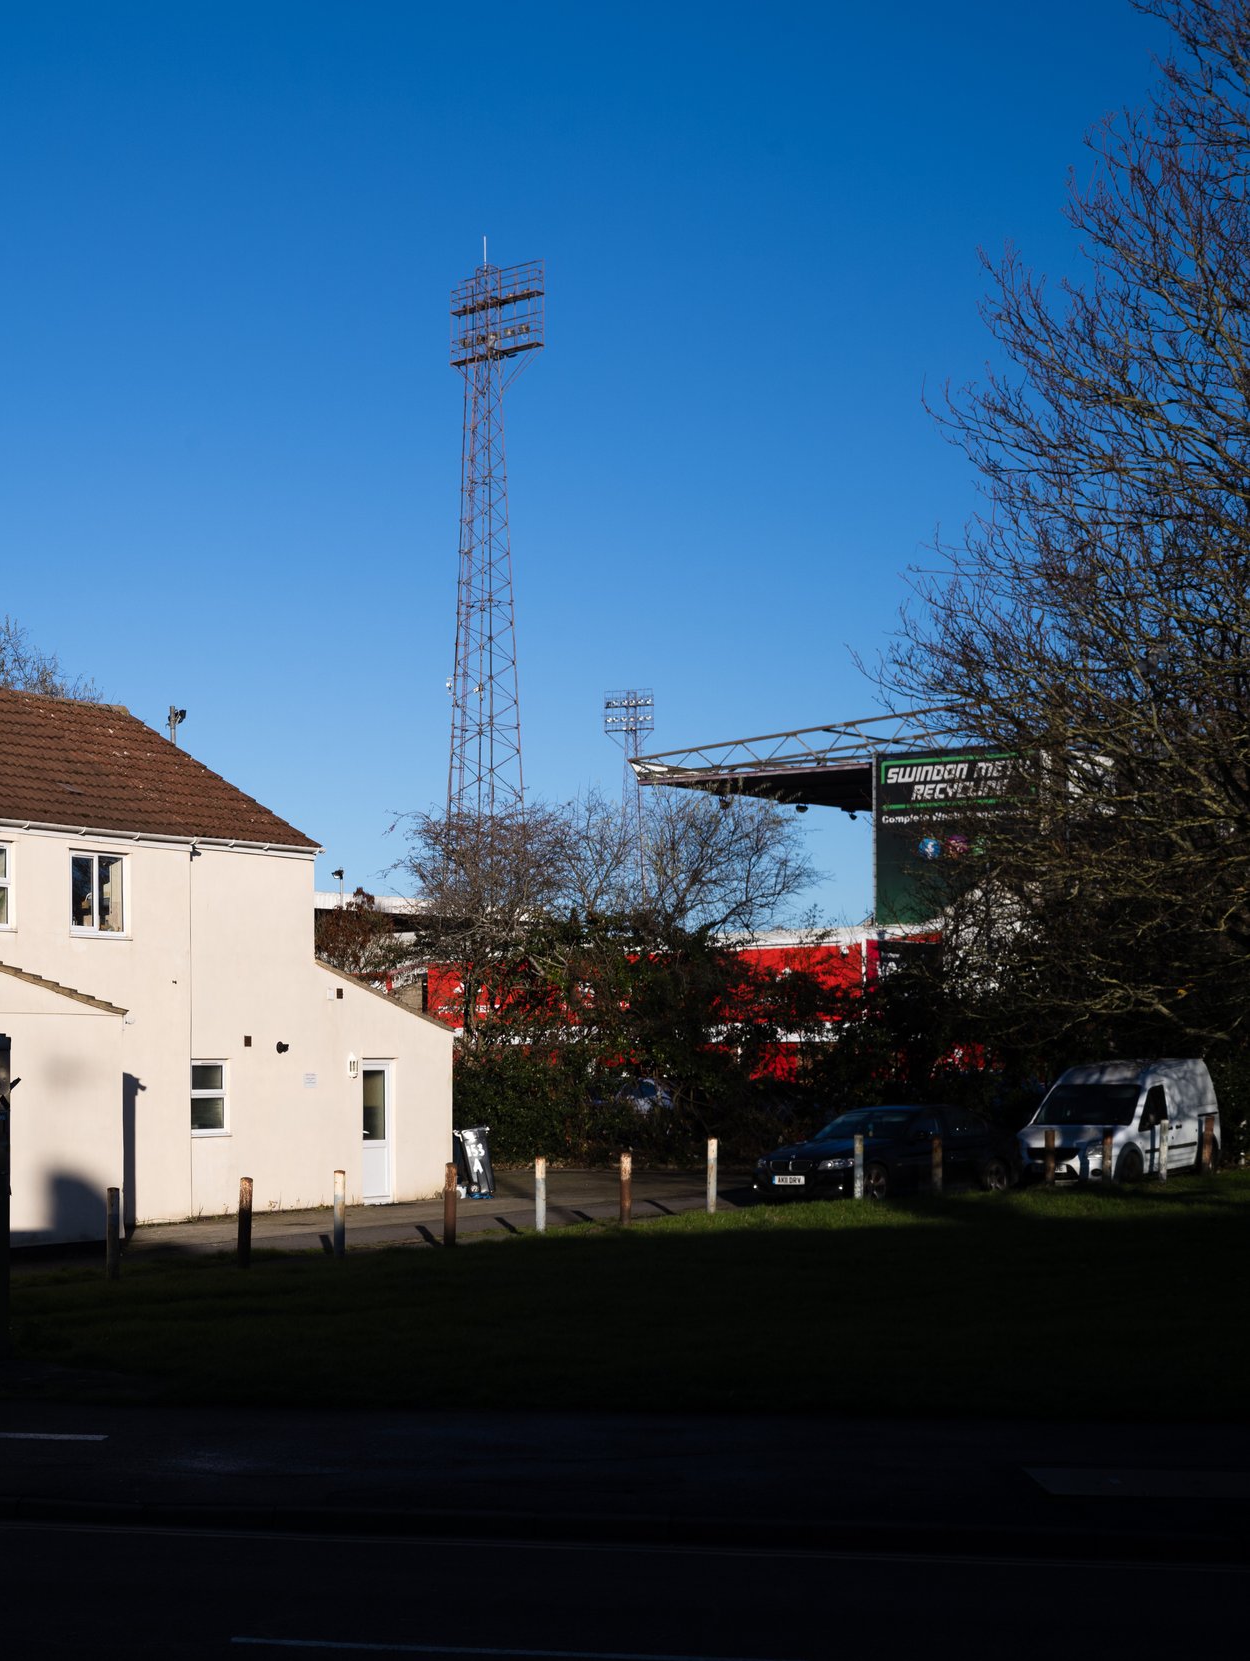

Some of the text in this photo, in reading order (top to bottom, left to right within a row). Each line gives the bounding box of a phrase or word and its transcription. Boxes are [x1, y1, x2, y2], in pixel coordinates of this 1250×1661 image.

[887, 763, 968, 784] SWINDON
[465, 1143, 486, 1157] 153
[473, 1158, 484, 1174] A
